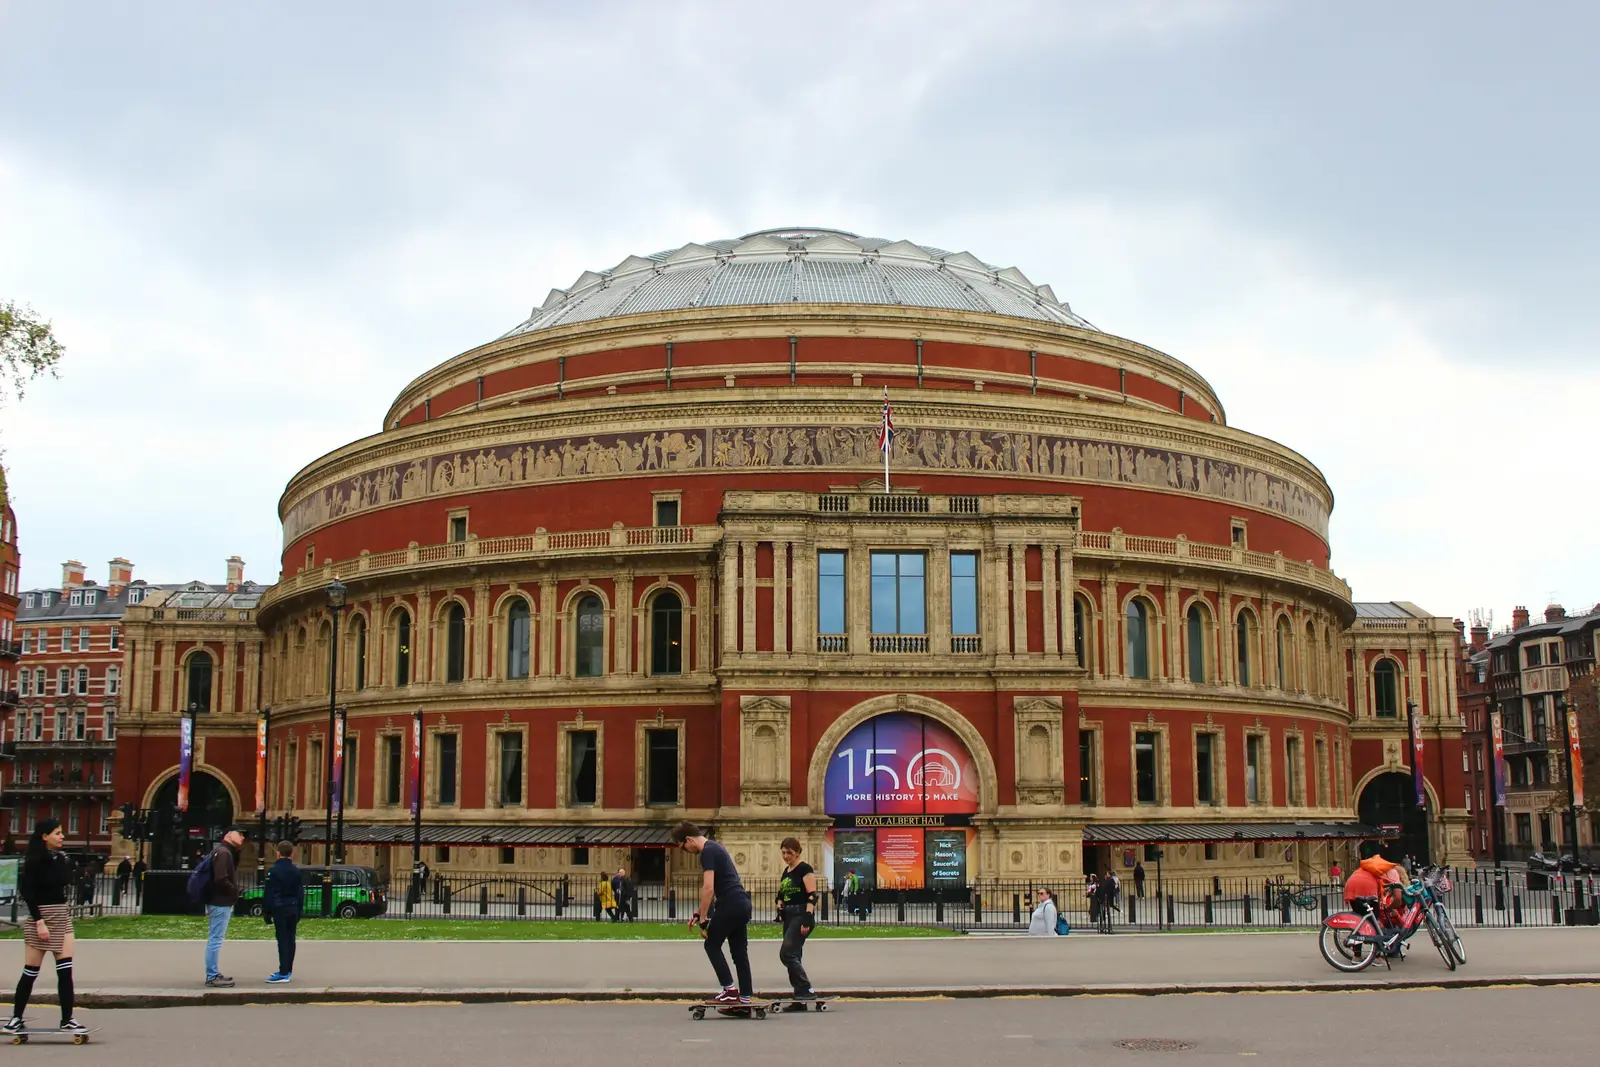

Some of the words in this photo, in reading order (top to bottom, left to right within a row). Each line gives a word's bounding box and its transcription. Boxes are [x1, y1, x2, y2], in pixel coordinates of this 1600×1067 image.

[1569, 716, 1581, 751] 150
[838, 748, 960, 790] 150
[845, 793, 872, 801] MORE
[875, 793, 914, 801] HISTORY
[917, 793, 930, 801] TO
[933, 793, 959, 801] MAKE
[856, 816, 885, 825] ROYAL
[886, 816, 920, 825] ALBERT
[921, 816, 944, 825] HALL
